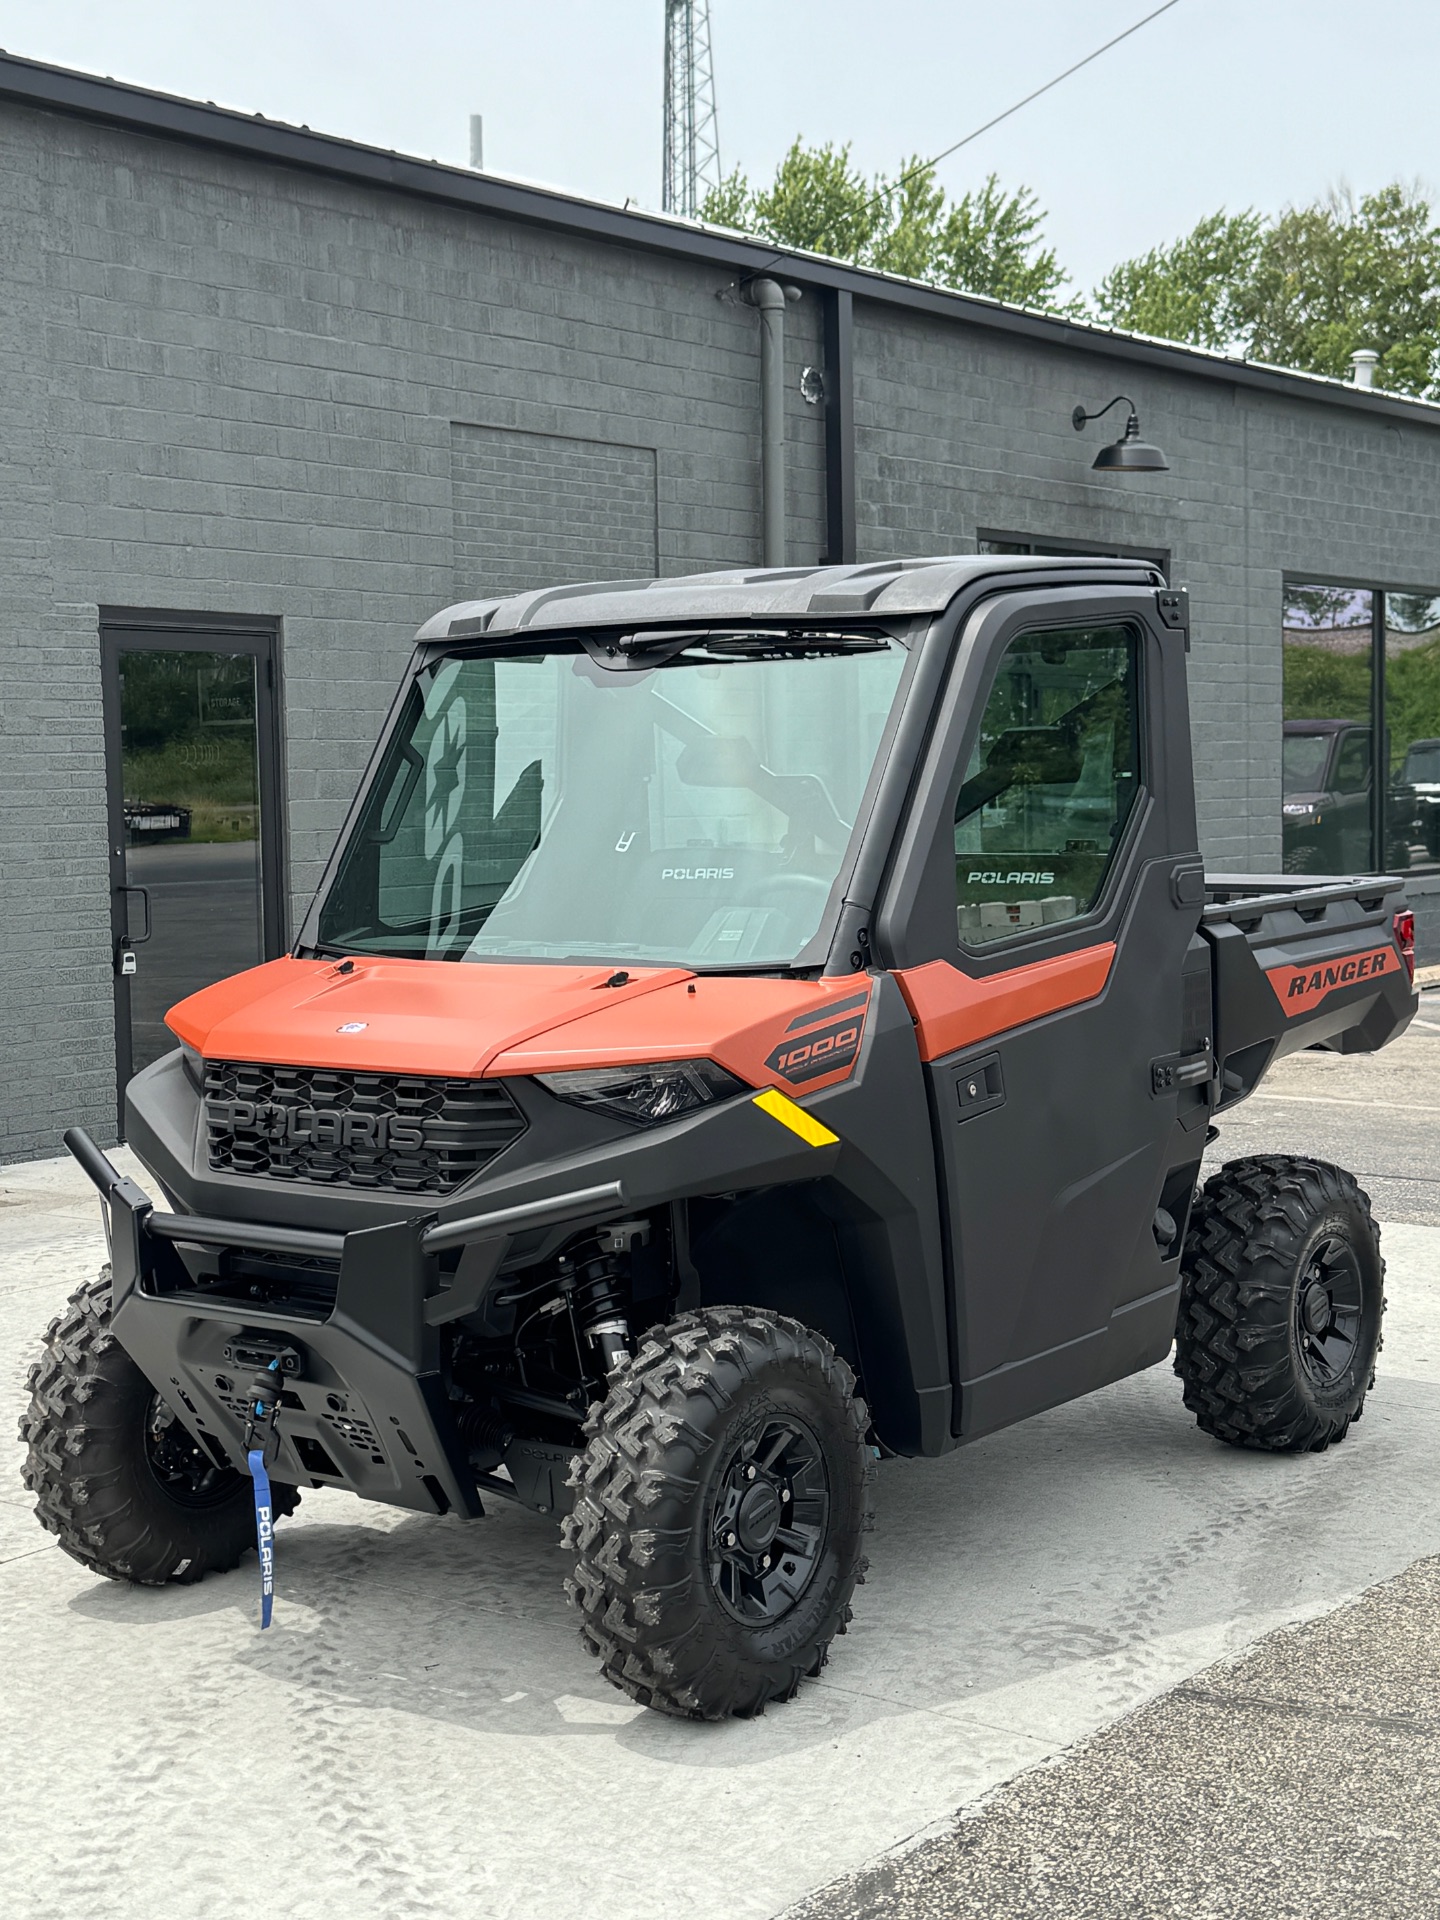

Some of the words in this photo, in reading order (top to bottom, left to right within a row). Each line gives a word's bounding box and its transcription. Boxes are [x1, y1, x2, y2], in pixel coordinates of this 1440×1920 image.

[661, 867, 735, 880] POLARIS
[966, 871, 1055, 884] POLARIS
[1287, 952, 1387, 998] RANGER
[777, 1027, 858, 1071] 1000
[226, 1100, 425, 1151] POLARIS
[258, 1506, 273, 1596] POLARIS
